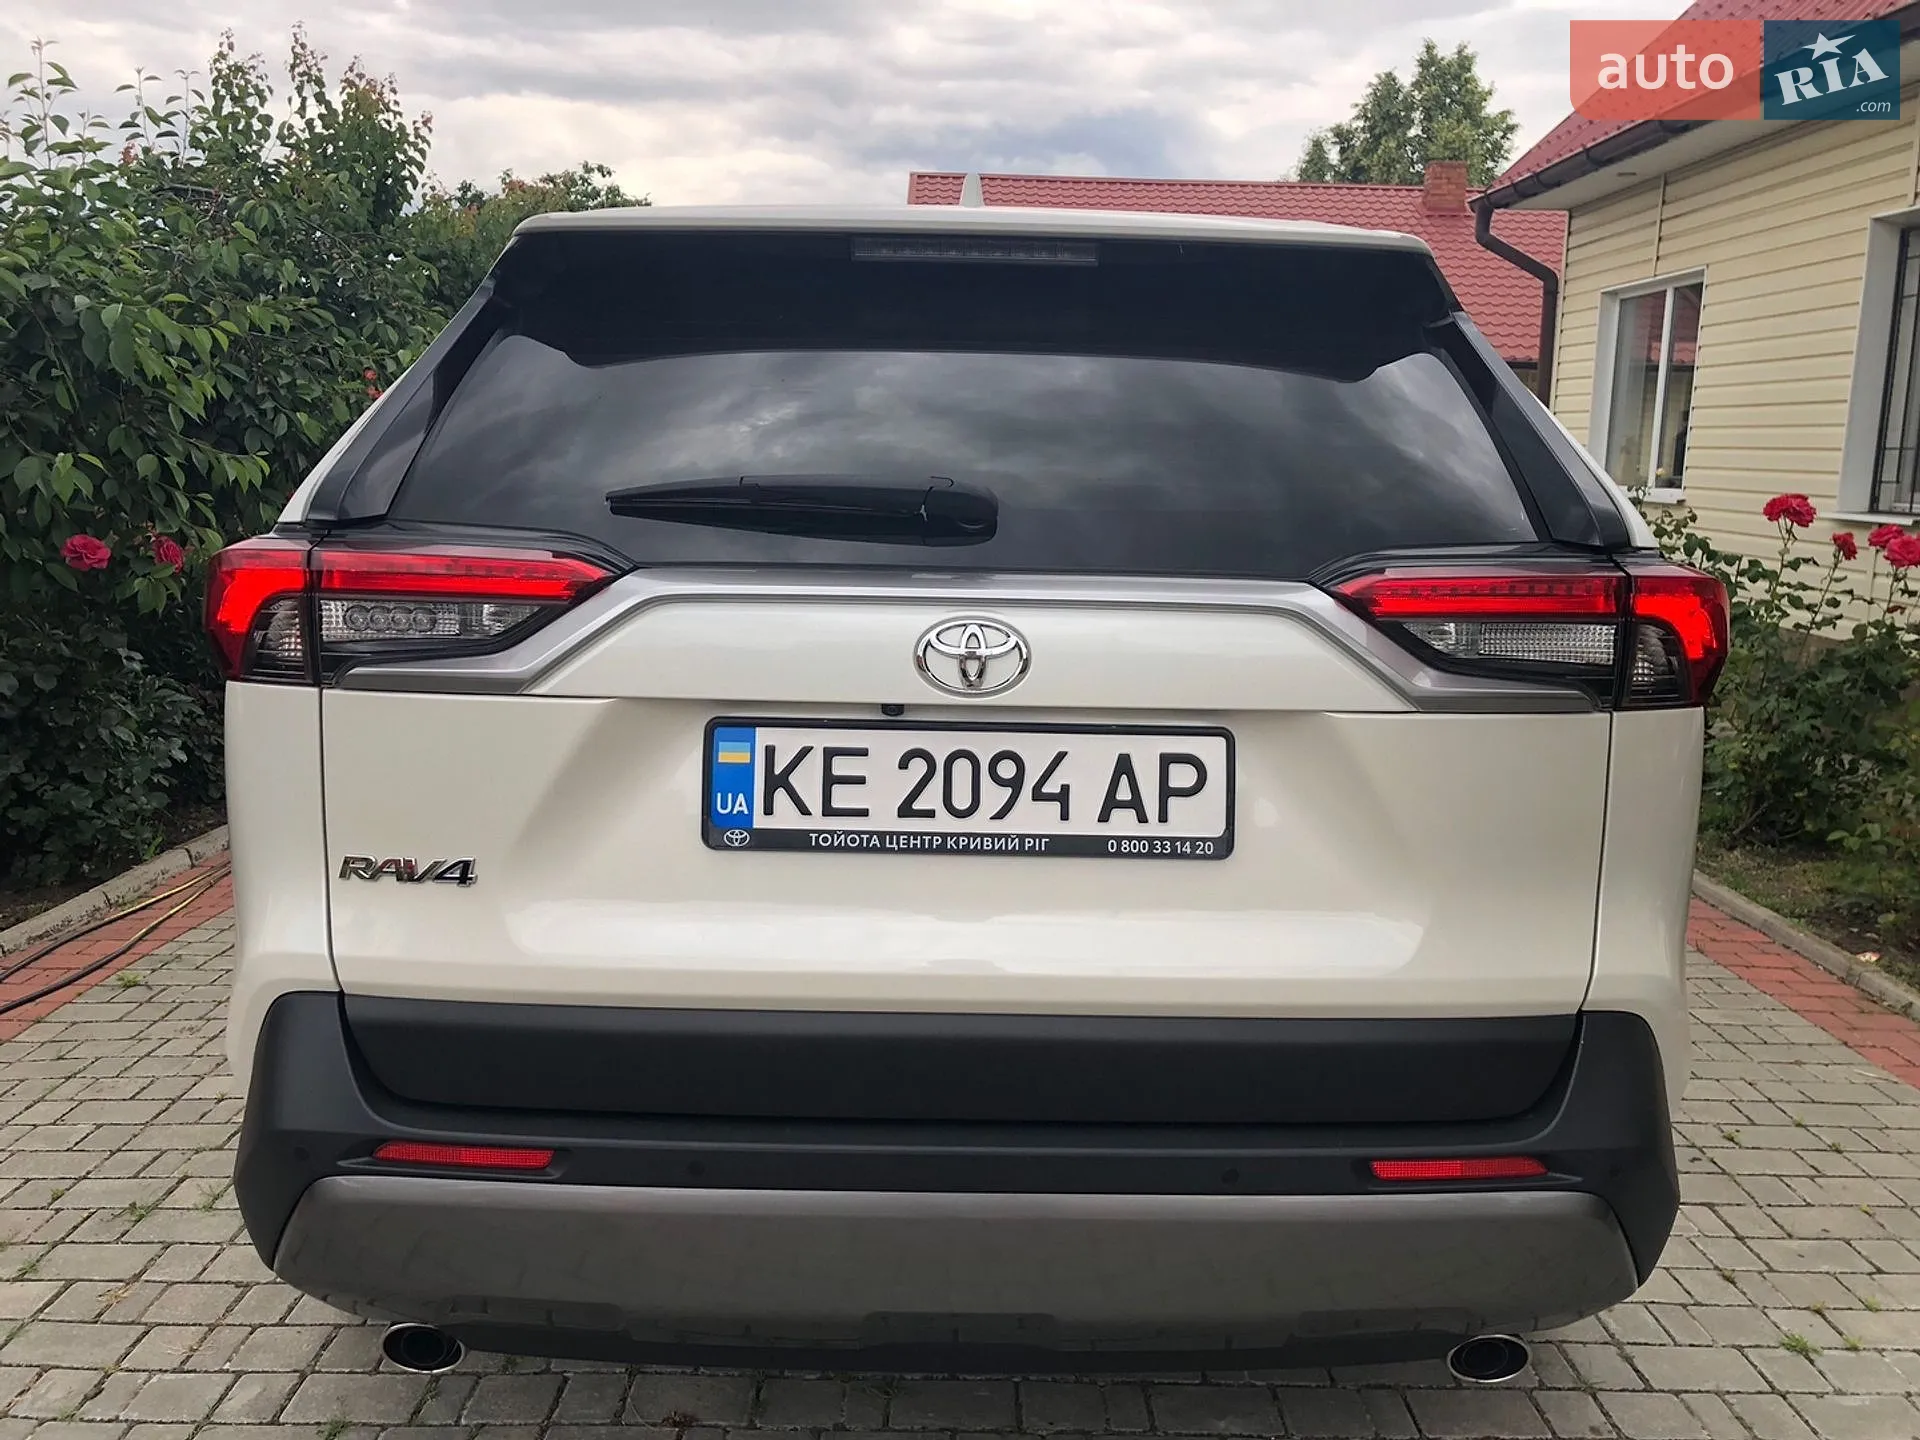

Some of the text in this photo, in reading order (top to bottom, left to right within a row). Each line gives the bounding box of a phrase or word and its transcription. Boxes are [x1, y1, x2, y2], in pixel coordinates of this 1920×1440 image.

[896, 748, 1070, 822] 2094
[716, 792, 749, 815] UA
[809, 831, 1050, 851] ТОЙОТА ЦЕНТР КРИВИЙ РІГ
[1108, 840, 1214, 855] 0 800 33 14 20
[339, 854, 478, 887] RAV4
